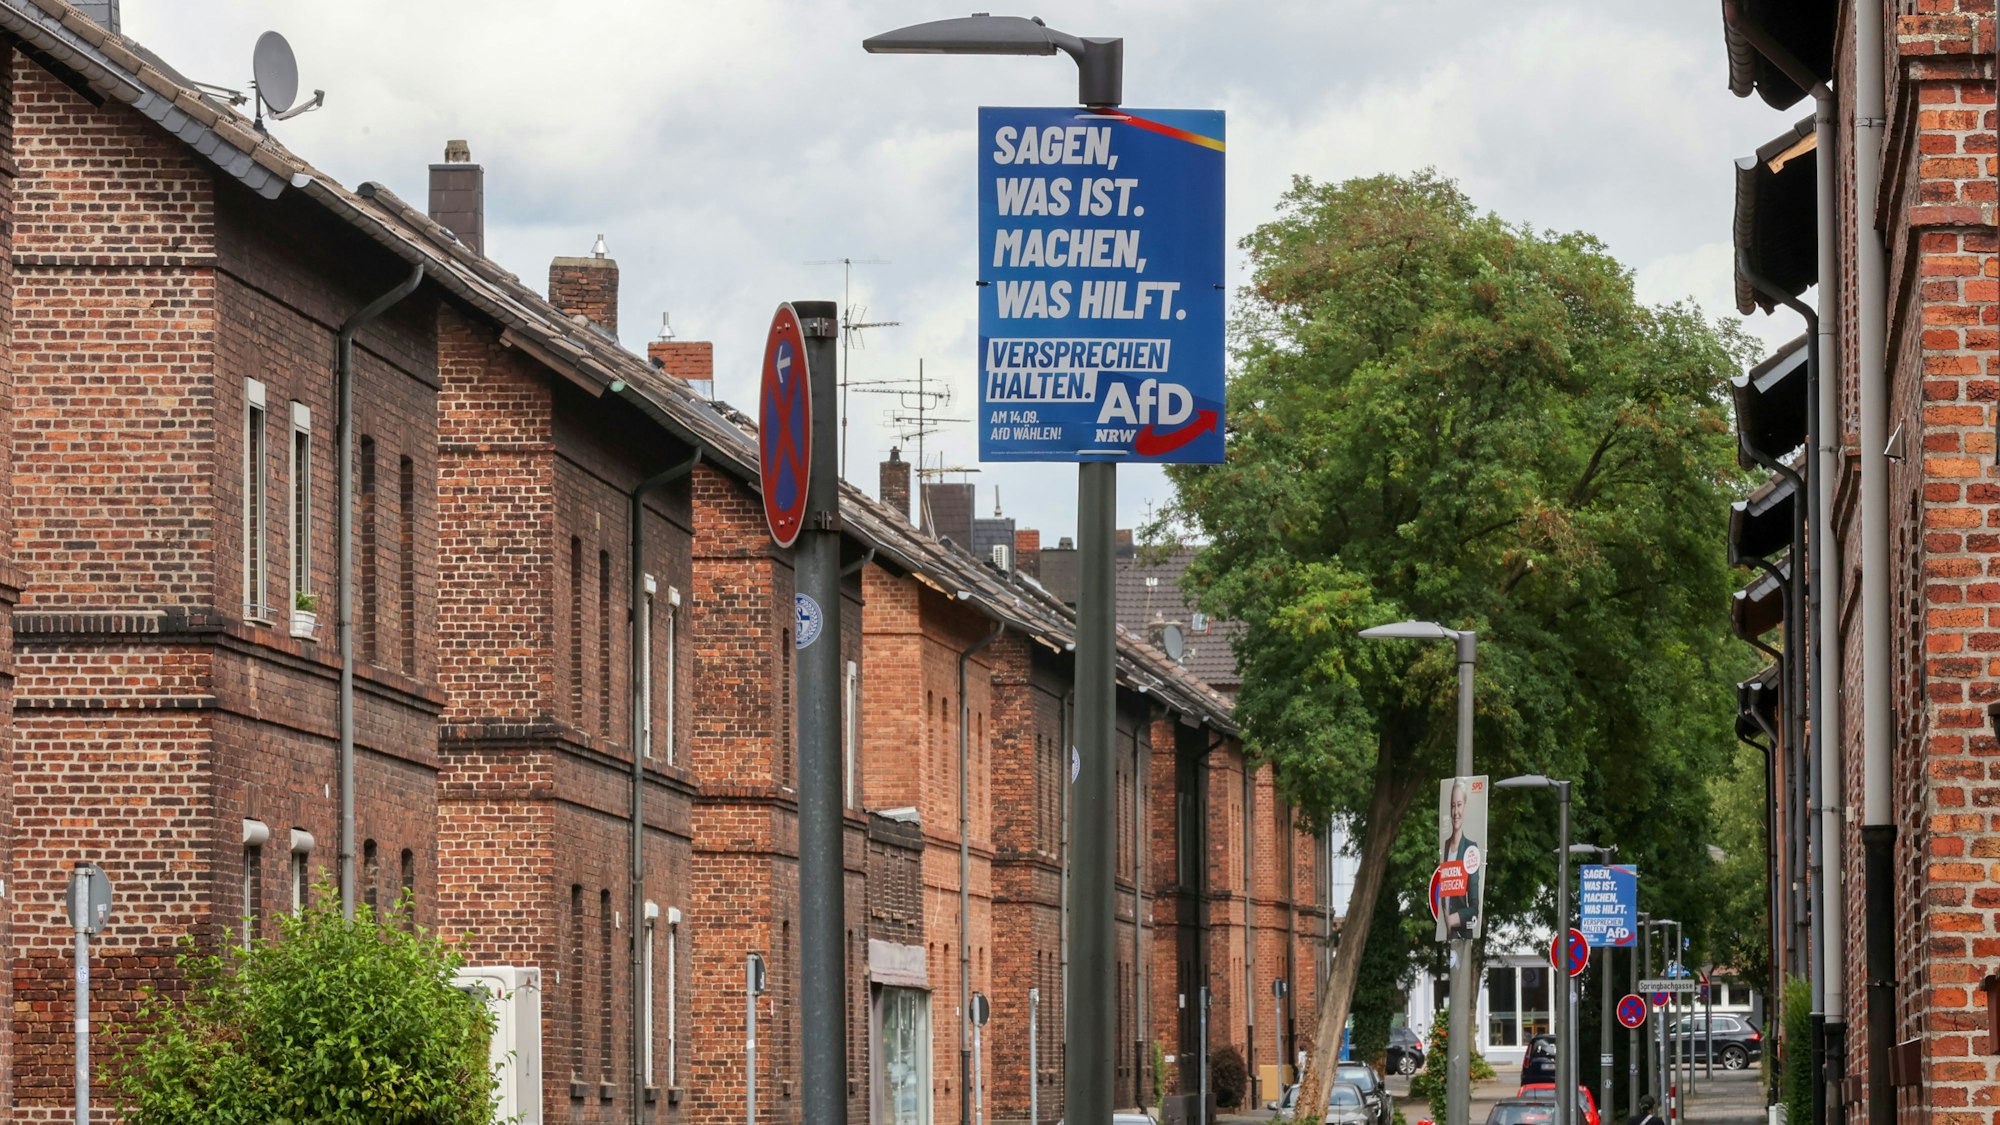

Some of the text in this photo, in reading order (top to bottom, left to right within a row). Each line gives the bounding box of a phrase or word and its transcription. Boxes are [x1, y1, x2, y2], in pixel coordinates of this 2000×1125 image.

[994, 126, 1118, 170] SAGEN,
[996, 178, 1145, 216] WAS IST.
[993, 229, 1147, 273] MACHEN,
[996, 280, 1187, 320] WAS HILFT.
[992, 341, 1166, 369] VERSPRECHEN
[990, 372, 1092, 400] HALTEN.
[1096, 378, 1194, 425] AfD
[990, 411, 1040, 424] AM 14.09.
[990, 424, 1062, 441] AfD WÄHLEN!
[1094, 429, 1136, 443] NRW
[1472, 782, 1482, 791] SPD
[1583, 869, 1611, 880] SAGEN,
[1584, 881, 1618, 891] WAS IST.
[1583, 893, 1618, 903] MACHEN,
[1584, 905, 1628, 915] WAS HILFT.
[1606, 927, 1630, 939] AfD
[1640, 982, 1693, 991] Springbachgasse
